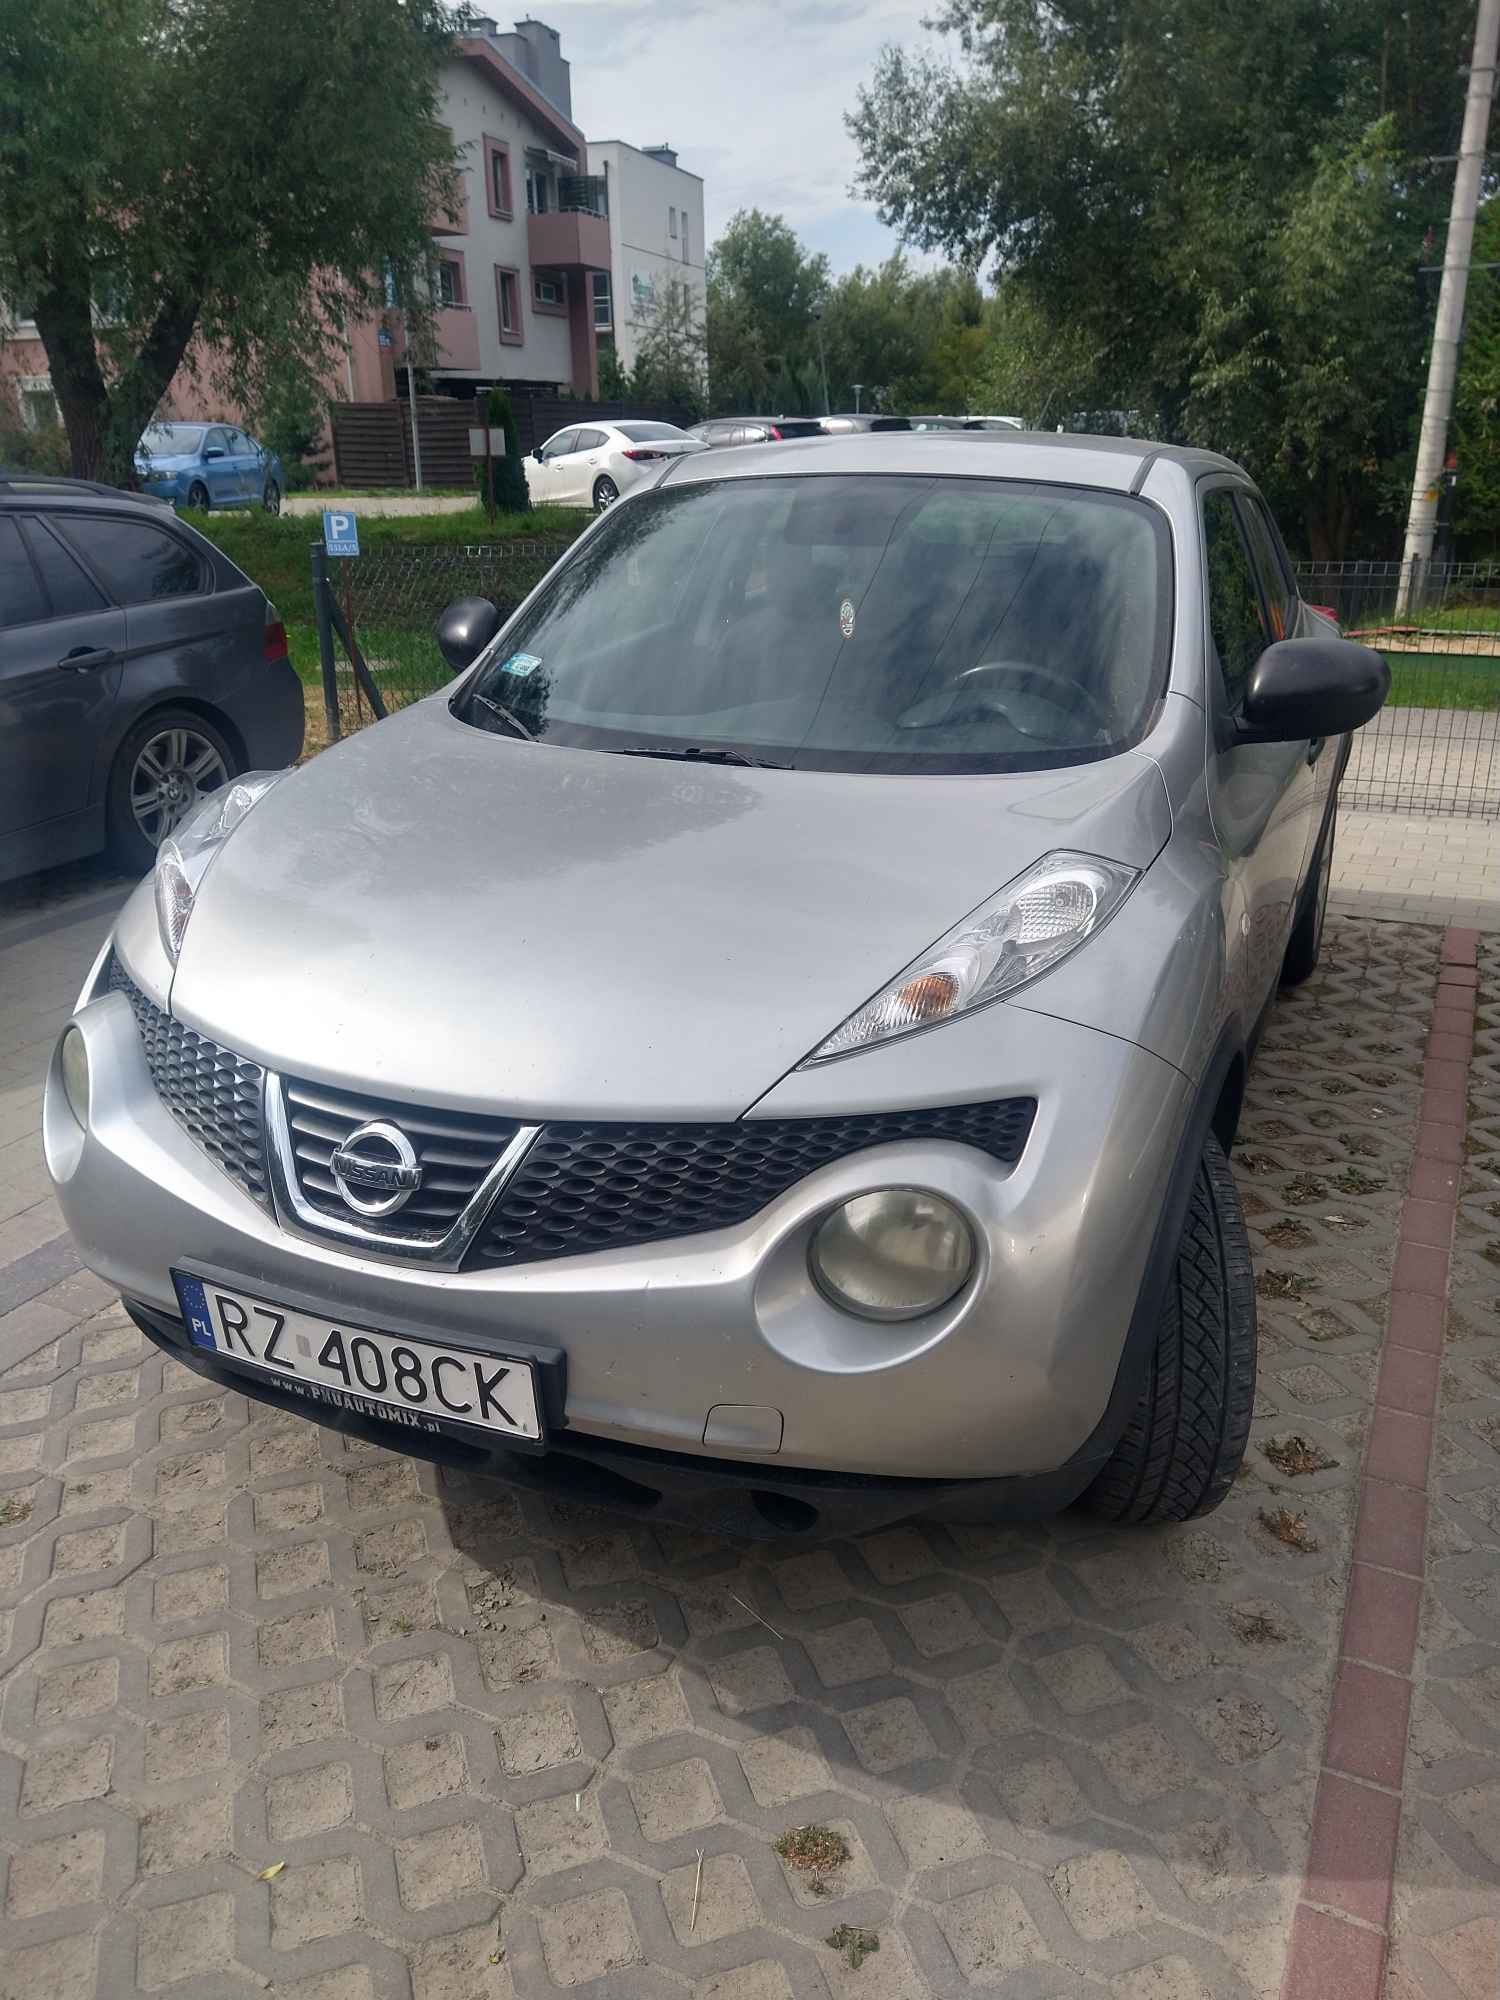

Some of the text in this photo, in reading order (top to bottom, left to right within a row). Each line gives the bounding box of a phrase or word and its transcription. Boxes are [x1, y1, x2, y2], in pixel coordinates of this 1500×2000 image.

[331, 515, 349, 539] P
[192, 1318, 211, 1336] PL
[215, 1295, 517, 1426] RZ 408CK
